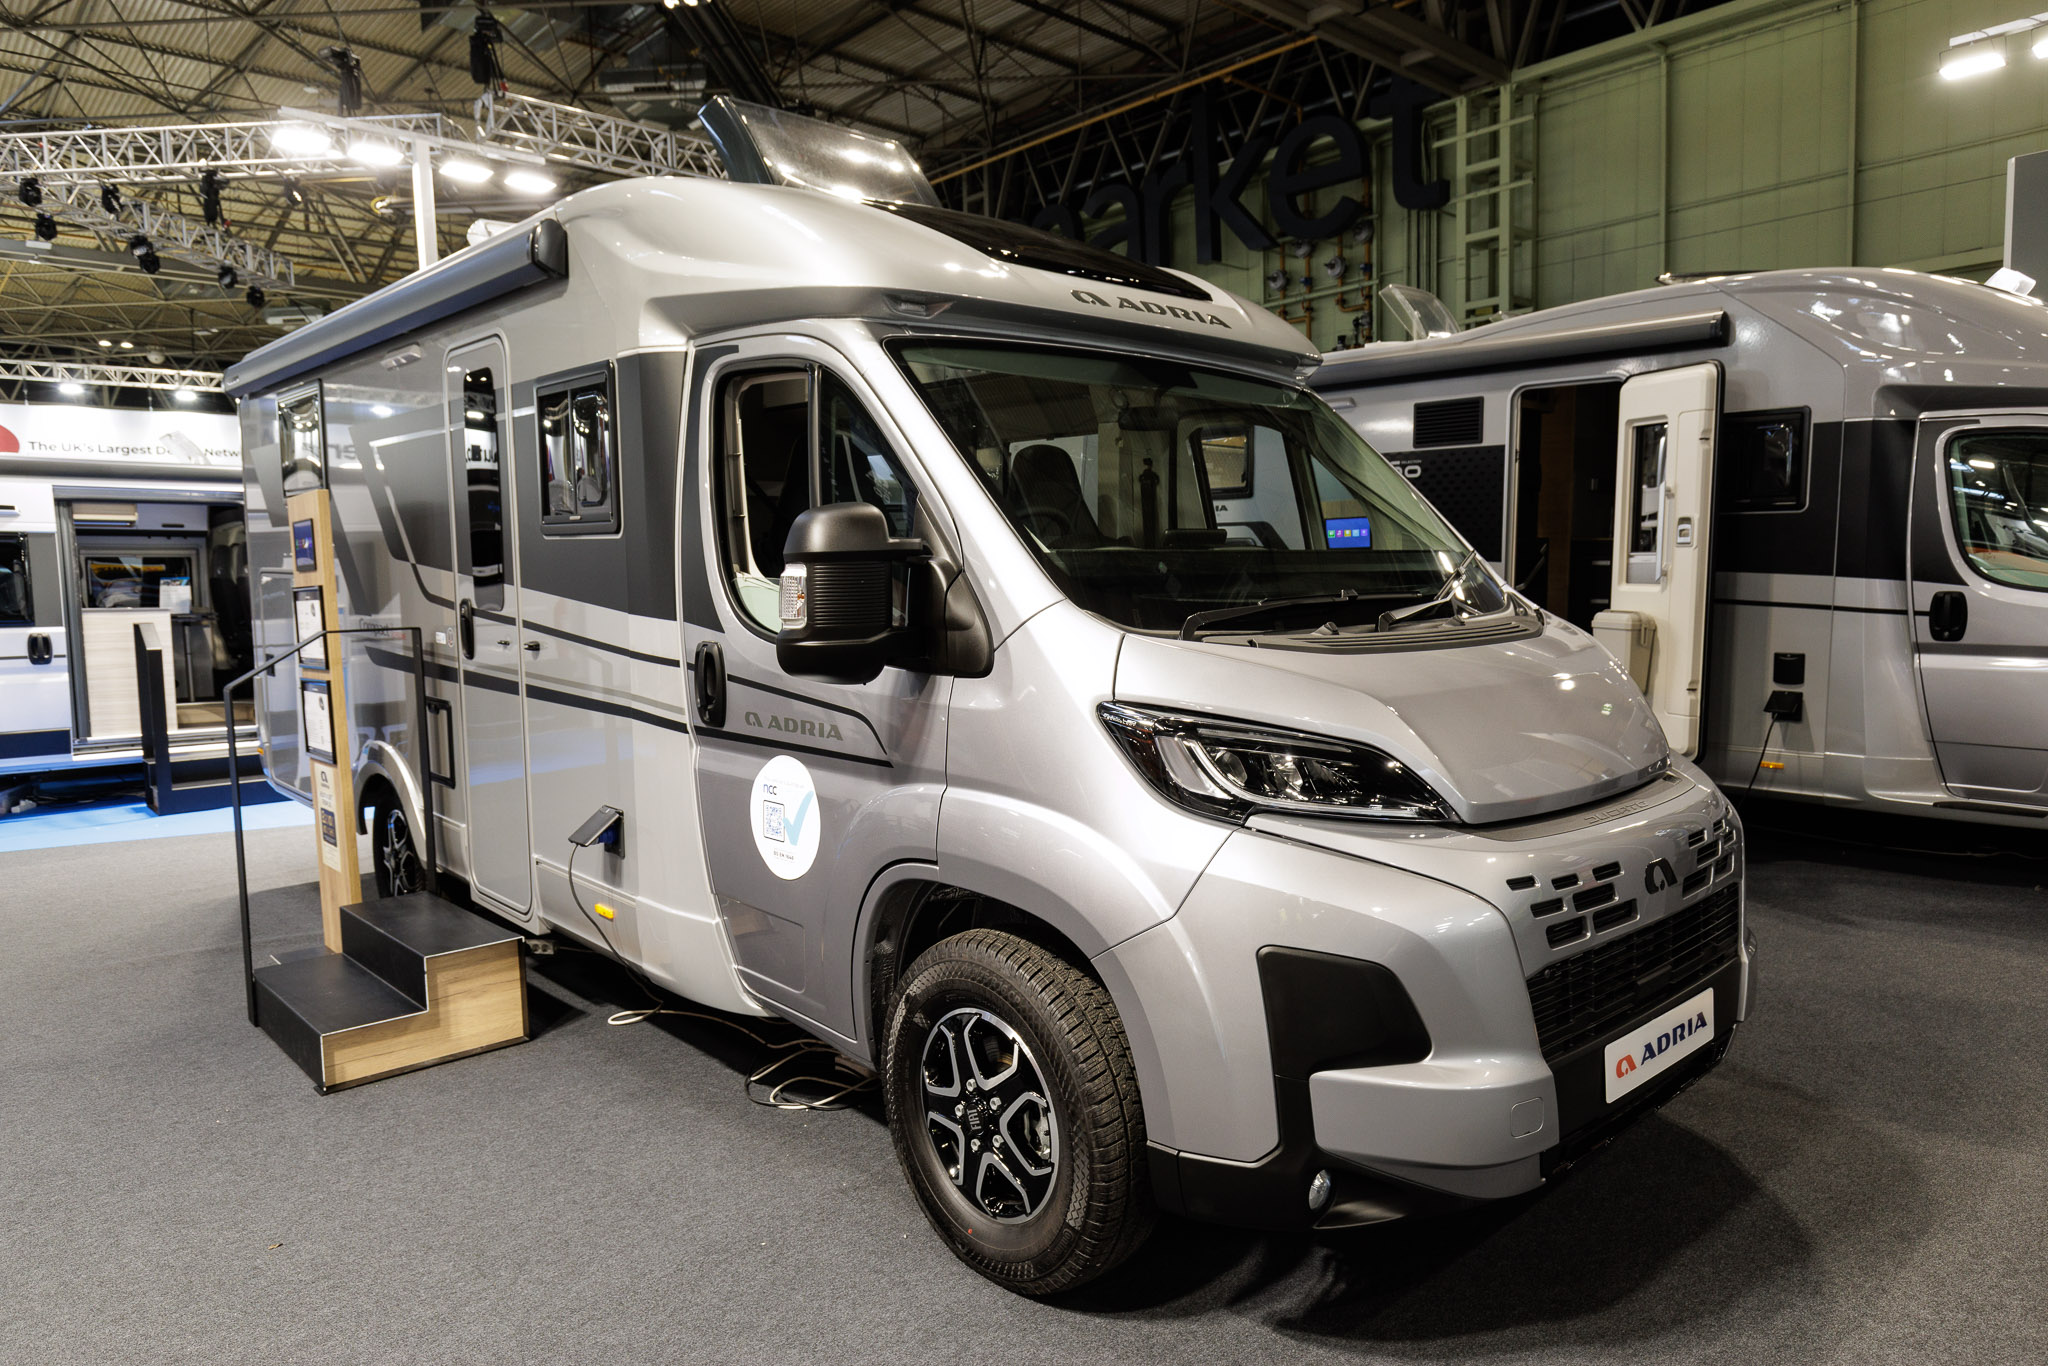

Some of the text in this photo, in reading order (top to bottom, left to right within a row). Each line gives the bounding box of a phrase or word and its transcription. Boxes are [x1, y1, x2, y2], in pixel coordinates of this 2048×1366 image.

[1117, 296, 1232, 330] ADRIA
[28, 441, 57, 452] The
[61, 442, 95, 453] UK's
[97, 444, 152, 457] Largest
[204, 448, 241, 458] Netw
[767, 715, 844, 742] ADRIA
[763, 783, 777, 796] ncc
[1640, 1011, 1708, 1067] ADRIA
[967, 1109, 981, 1130] FIAT
